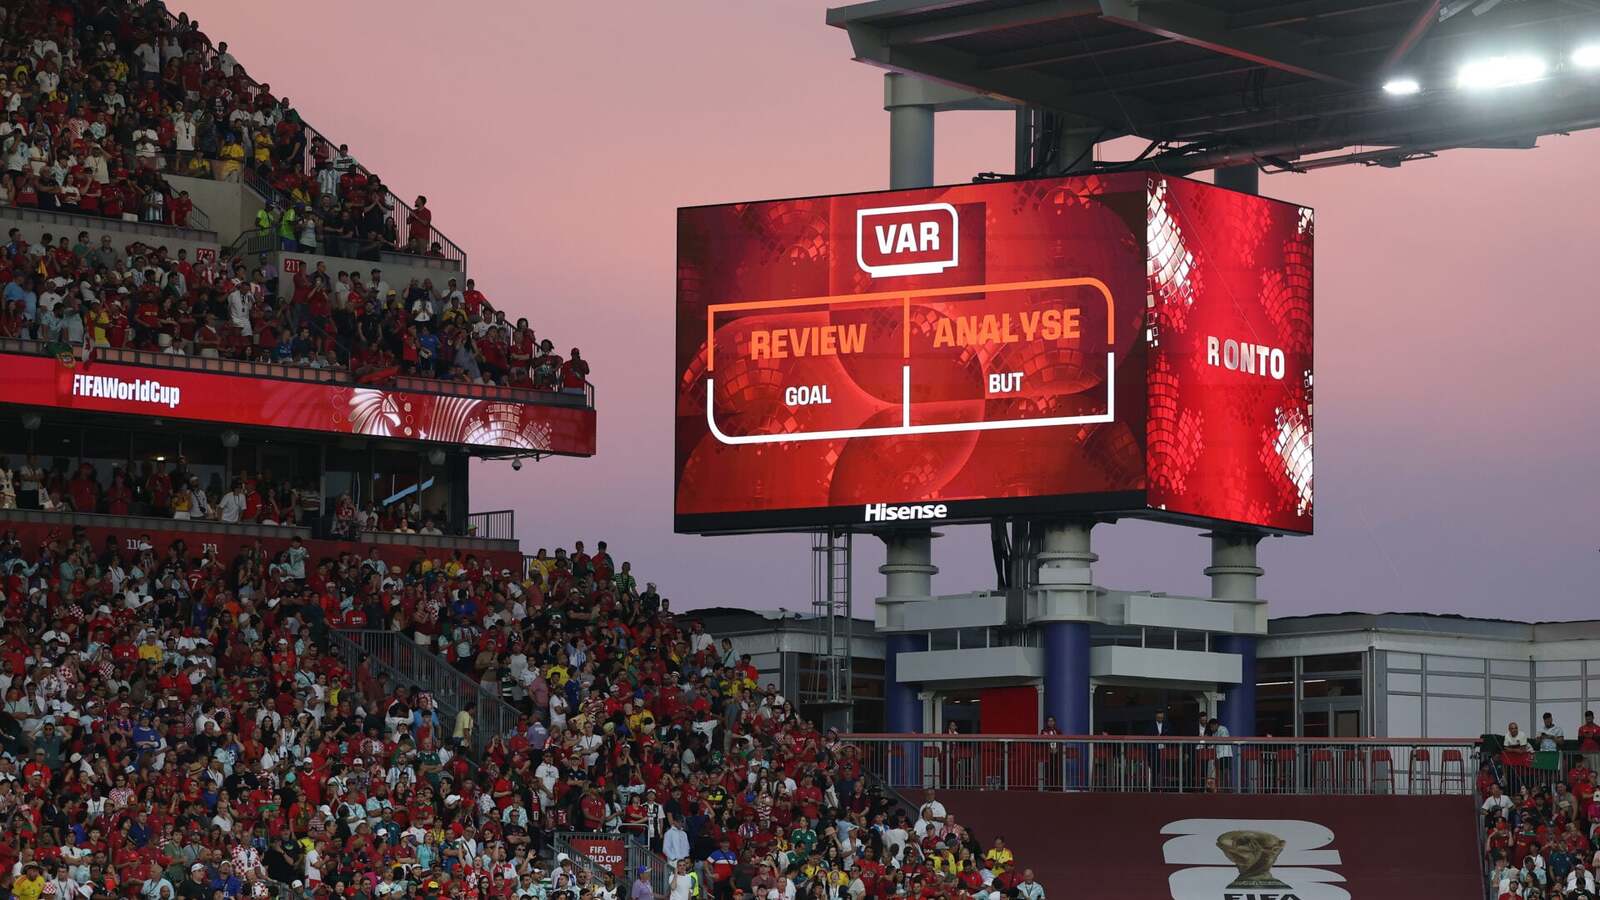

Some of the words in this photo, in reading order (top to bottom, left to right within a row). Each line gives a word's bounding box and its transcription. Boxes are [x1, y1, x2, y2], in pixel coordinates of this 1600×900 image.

[875, 221, 940, 254] VAR
[286, 260, 300, 272] 211
[751, 323, 867, 360] REVIEW
[933, 308, 1081, 348] ANALYSE
[72, 374, 180, 408] FIFAWorldCup
[785, 385, 832, 406] GOAL
[989, 372, 1024, 394] BUT
[864, 503, 948, 522] Hisense
[590, 846, 608, 854] FIFA
[605, 855, 622, 863] CUP
